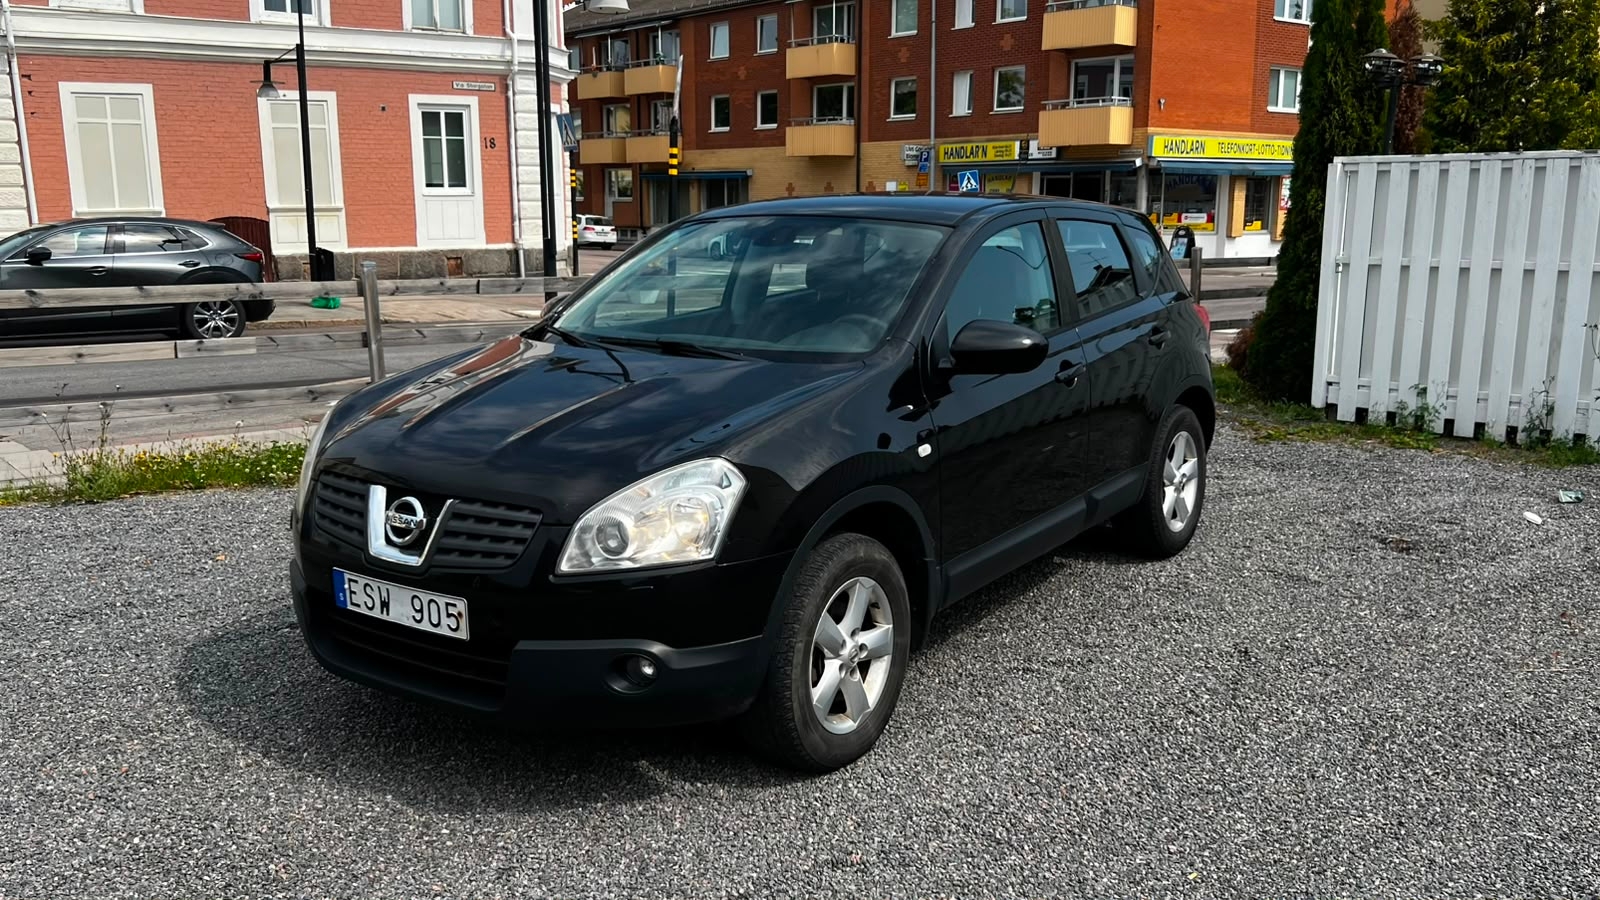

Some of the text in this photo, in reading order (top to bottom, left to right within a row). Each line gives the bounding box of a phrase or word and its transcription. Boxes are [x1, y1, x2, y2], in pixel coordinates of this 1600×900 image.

[484, 137, 496, 149] 18
[921, 151, 928, 162] P
[386, 513, 418, 527] NISSAN
[347, 577, 460, 633] ESW 905
